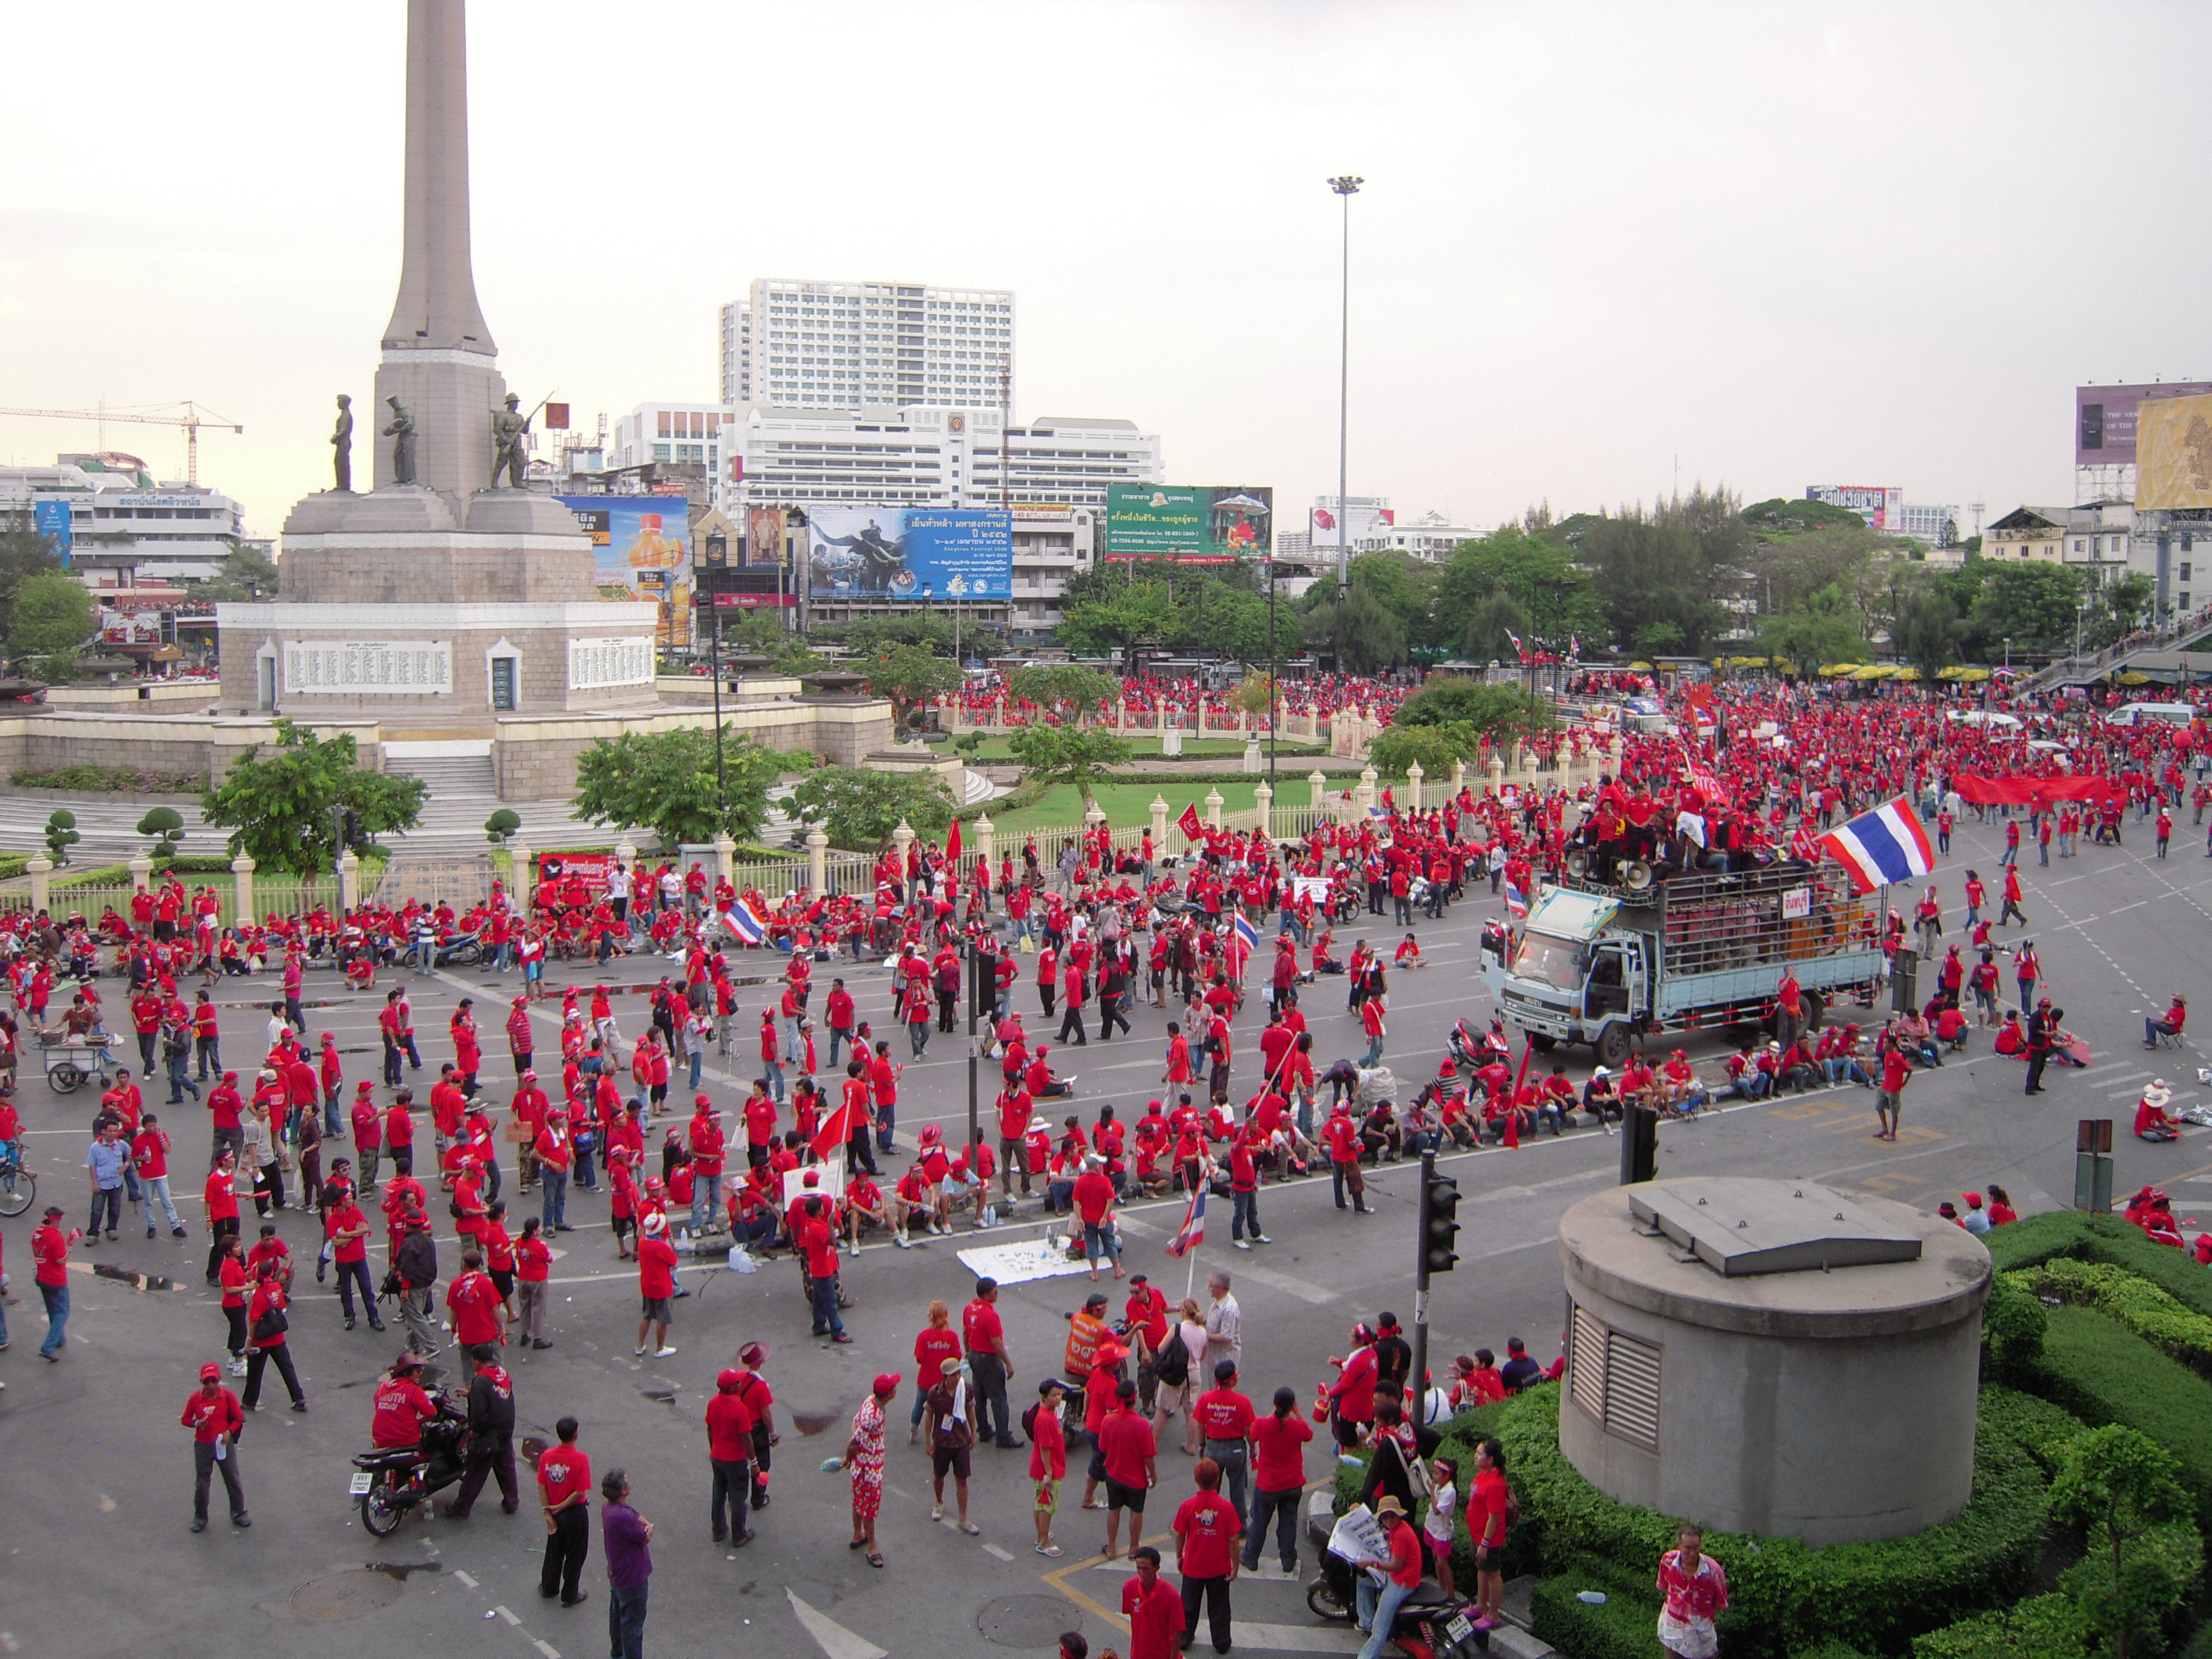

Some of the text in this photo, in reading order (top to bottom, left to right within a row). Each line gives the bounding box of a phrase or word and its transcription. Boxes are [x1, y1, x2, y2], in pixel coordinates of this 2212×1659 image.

[119, 496, 201, 506] สถาบันโรคผิวหนัง
[911, 516, 1007, 528] เย็นทั่วหล้า มหาสงกรานต์
[972, 529, 978, 538] ปี
[1524, 997, 1542, 1007] ISUZU
